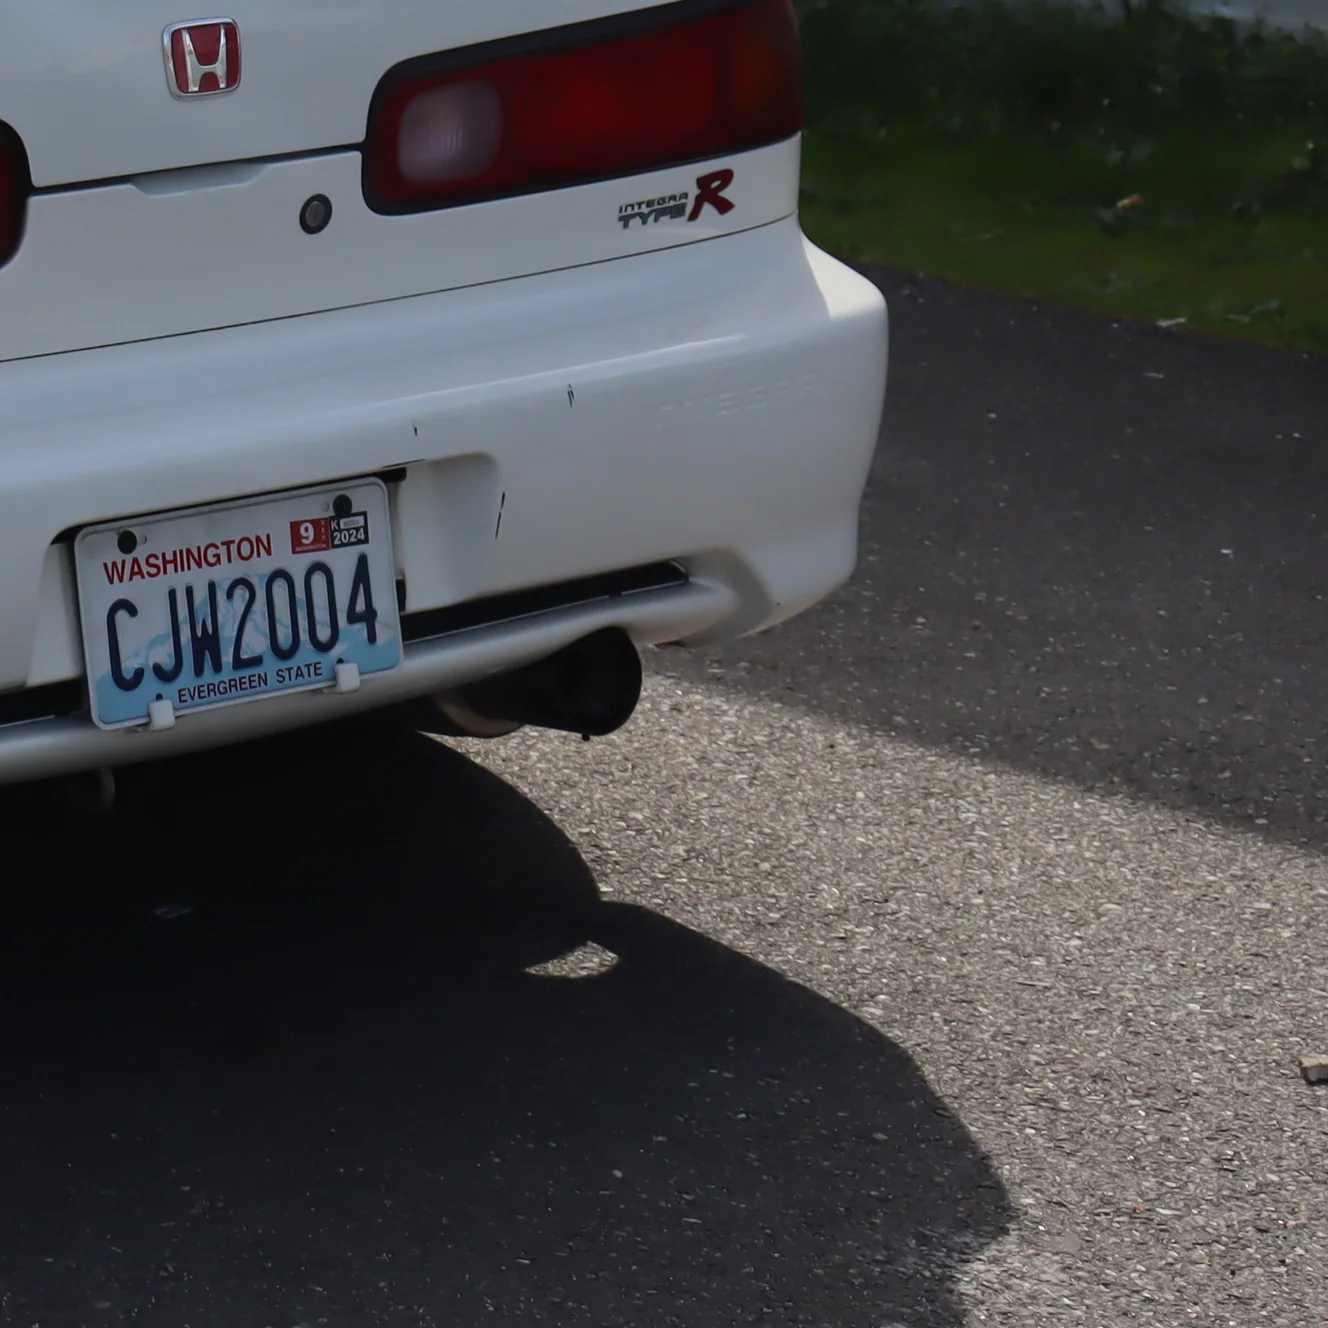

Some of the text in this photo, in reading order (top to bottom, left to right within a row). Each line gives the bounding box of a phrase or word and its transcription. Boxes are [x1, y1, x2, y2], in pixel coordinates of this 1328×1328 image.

[618, 167, 736, 230] TYPE R
[618, 191, 690, 215] INTEGRA
[299, 521, 315, 545] 9
[333, 527, 366, 545] 2024
[102, 533, 273, 585] WASHINGTON
[105, 551, 379, 692] CJW2004
[177, 661, 324, 704] EVERGREEN STATE
